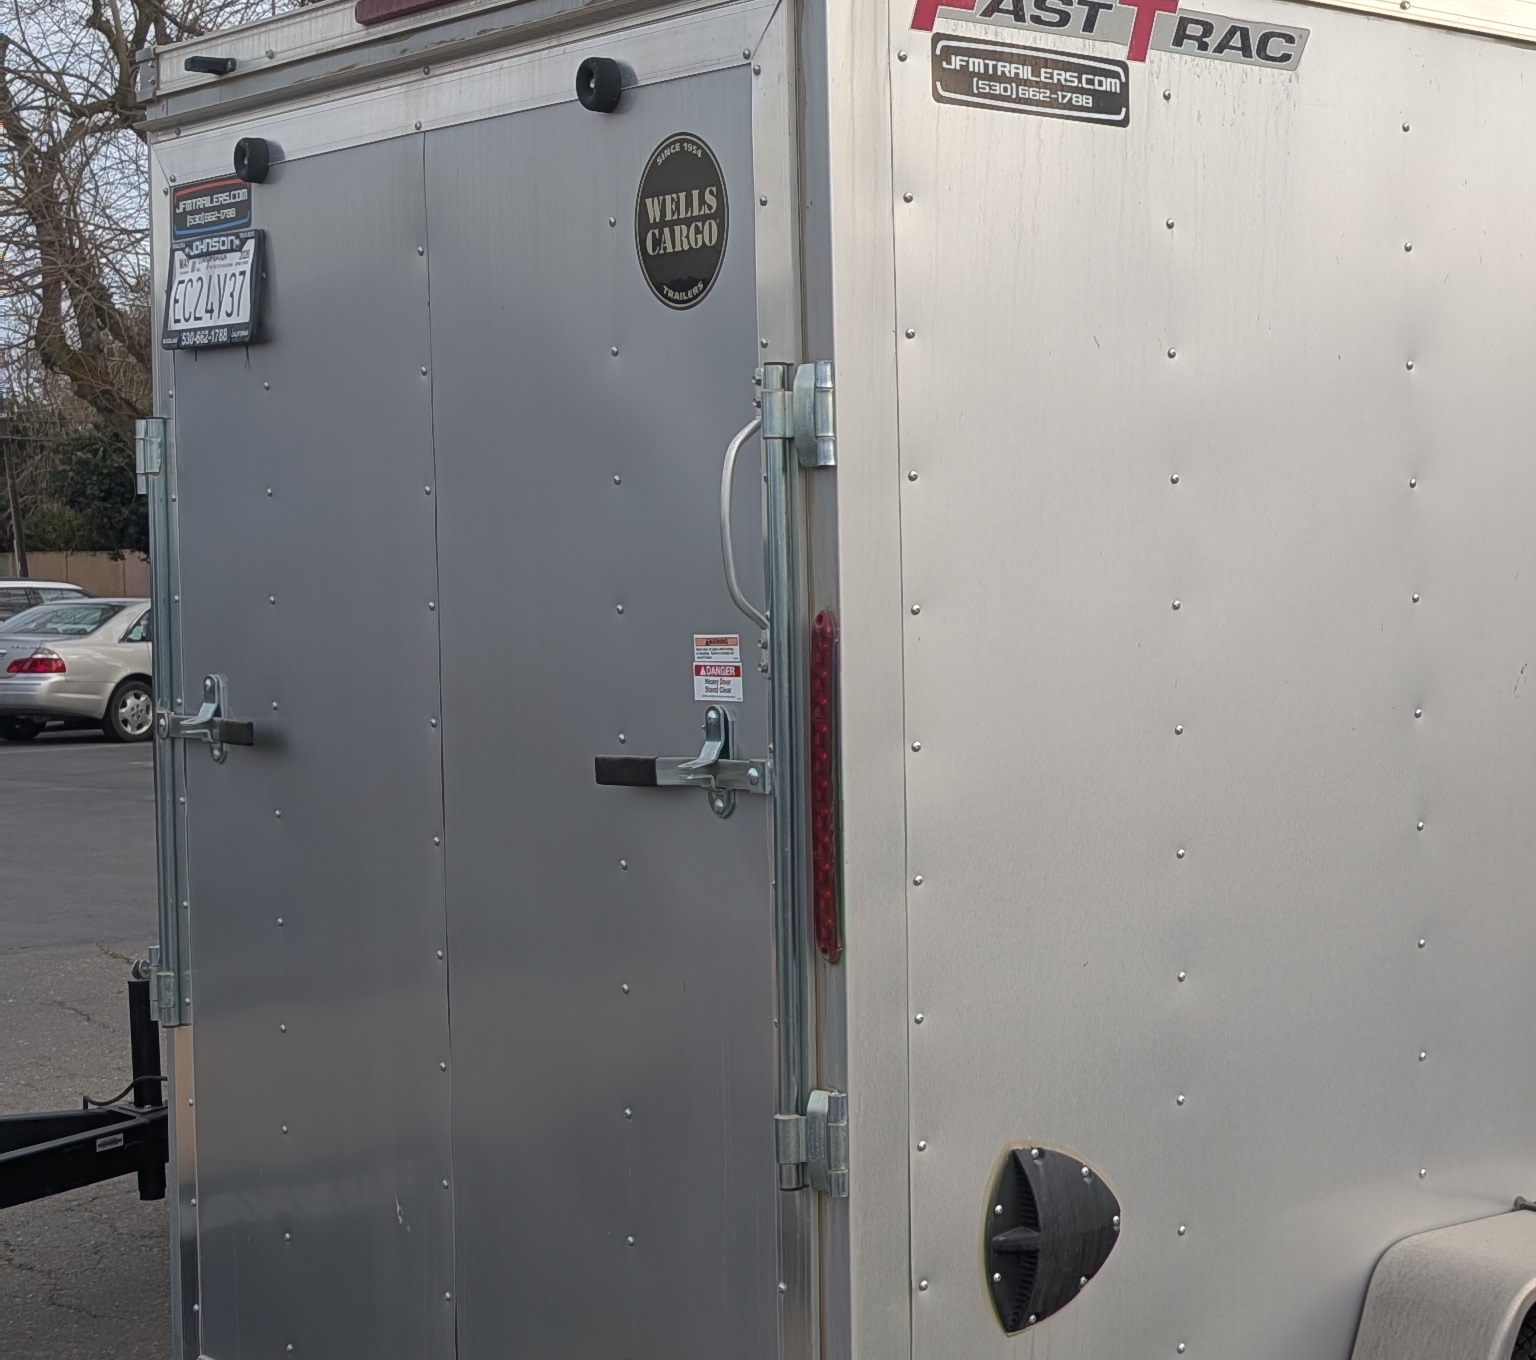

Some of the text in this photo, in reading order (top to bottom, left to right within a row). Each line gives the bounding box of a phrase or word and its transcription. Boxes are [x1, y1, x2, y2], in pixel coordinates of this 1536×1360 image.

[942, 54, 1121, 94] JFMTRAILERS.COM
[656, 142, 703, 166] SINCE 1954
[645, 186, 718, 224] WELLS
[646, 219, 719, 256] CARGO
[662, 280, 704, 301] TRAILERS
[706, 666, 735, 675] DANGER
